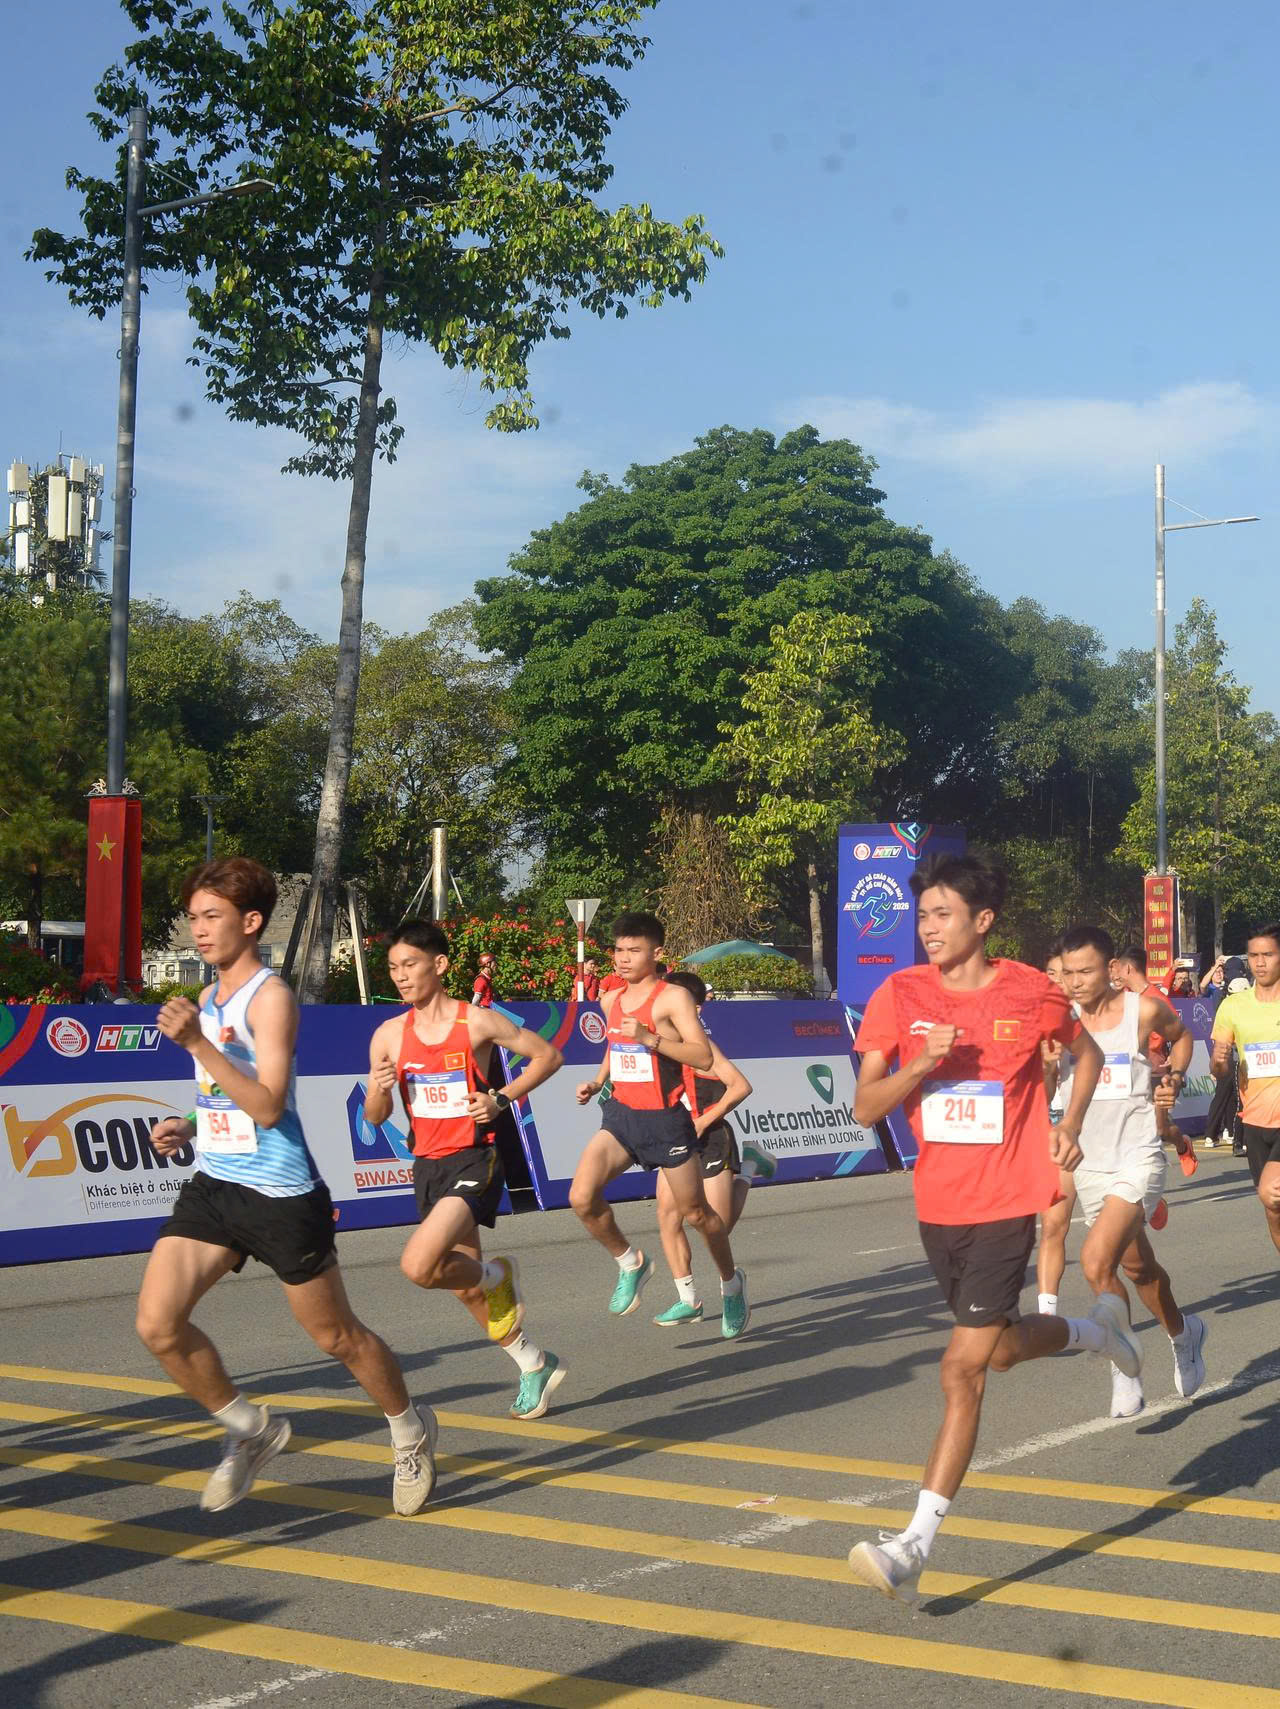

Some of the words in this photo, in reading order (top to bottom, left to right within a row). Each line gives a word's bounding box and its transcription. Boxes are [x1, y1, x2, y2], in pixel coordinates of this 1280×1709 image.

[873, 847, 901, 857] HTV
[892, 902, 910, 910] 2026
[99, 1029, 160, 1047] HTV
[620, 1054, 636, 1070] 169
[1256, 1052, 1276, 1066] 200
[424, 1086, 448, 1104] 166
[734, 1102, 858, 1134] Vietcombank
[944, 1098, 976, 1121] 214
[762, 1135, 800, 1150] NHÁNH
[802, 1132, 826, 1147] BÌNH
[828, 1130, 864, 1144] DƯƠNG
[86, 1184, 117, 1198] Khác
[120, 1182, 144, 1196] biệt
[148, 1180, 155, 1192] ở
[160, 1180, 181, 1192] chữ
[90, 1200, 131, 1210] Difference
[133, 1198, 140, 1206] in
